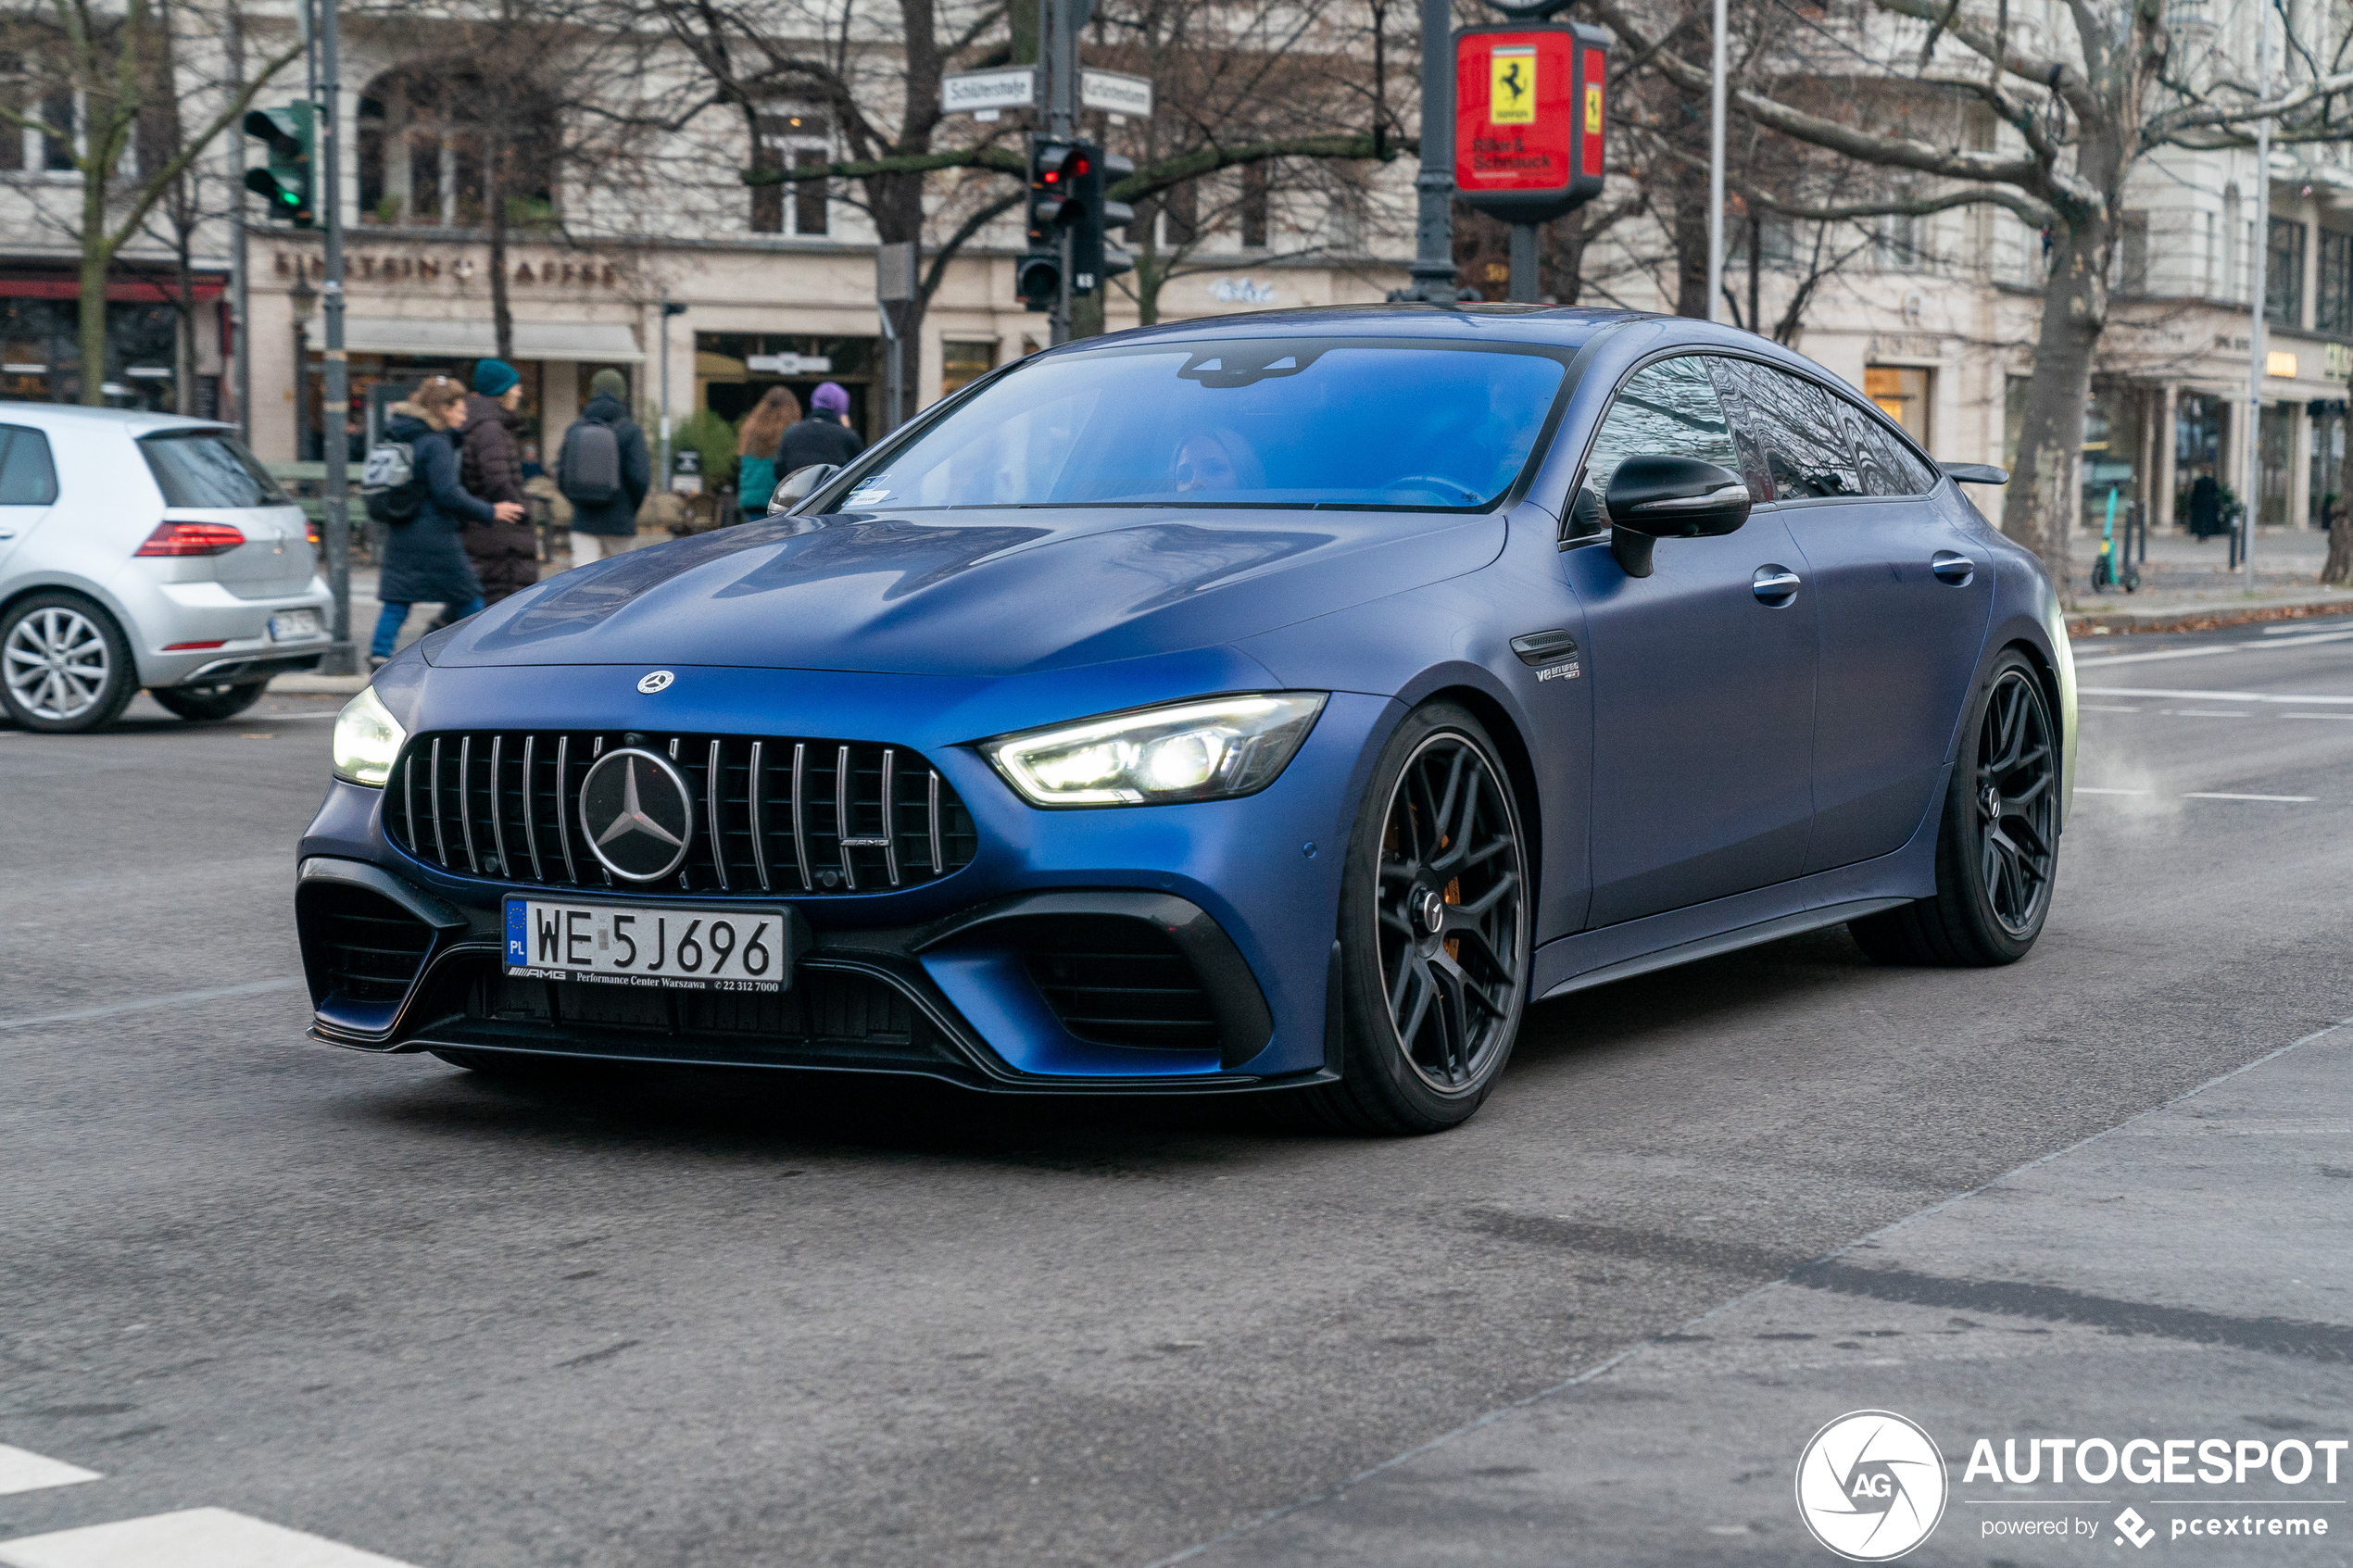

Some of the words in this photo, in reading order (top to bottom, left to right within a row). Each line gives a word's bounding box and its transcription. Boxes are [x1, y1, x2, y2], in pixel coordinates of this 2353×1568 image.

[1473, 154, 1552, 169] Schnauck
[498, 260, 616, 289] AFFEE
[1536, 669, 1552, 683] V8
[510, 940, 525, 956] PL
[536, 909, 593, 965] WE
[613, 914, 770, 976] 5J696
[527, 968, 566, 980] AMG
[576, 972, 629, 984] Performance
[630, 975, 660, 987] Center
[661, 978, 705, 989] Warszawa
[724, 982, 735, 990] 22
[736, 982, 753, 991] 312
[755, 982, 779, 992] 7000
